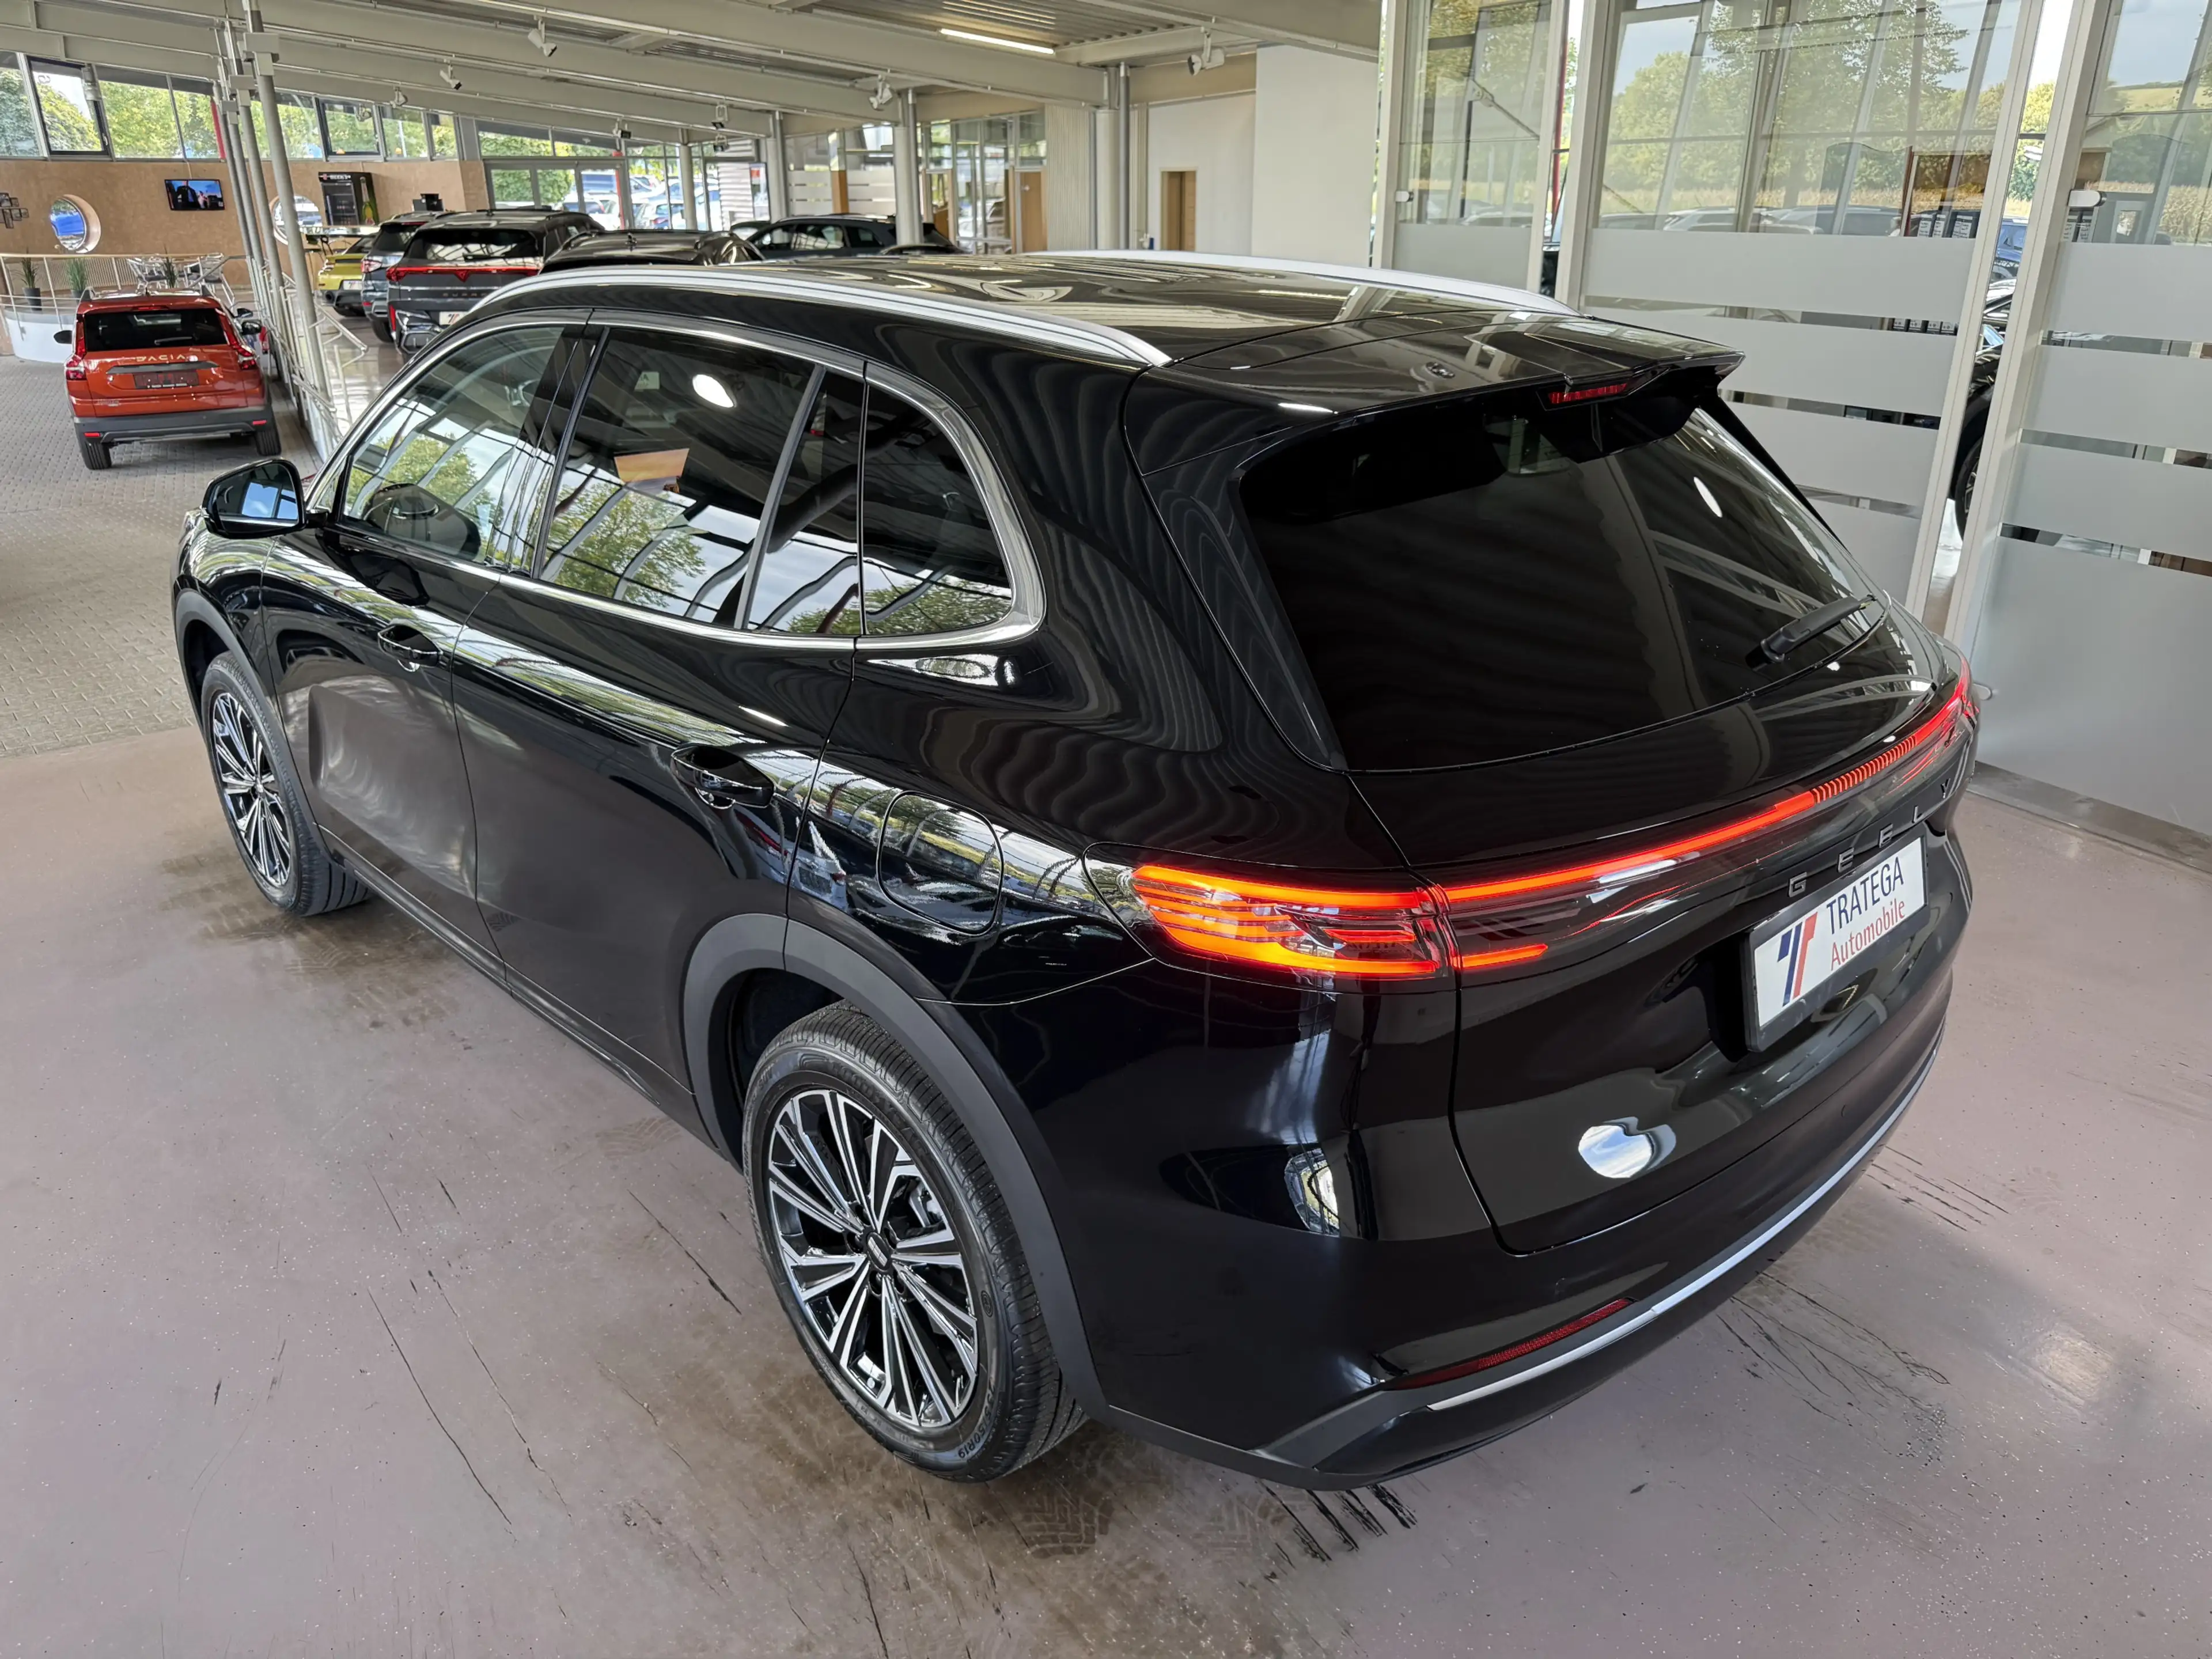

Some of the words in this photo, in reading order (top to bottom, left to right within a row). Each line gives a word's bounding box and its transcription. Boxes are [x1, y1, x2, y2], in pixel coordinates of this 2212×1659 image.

[135, 354, 185, 362] DACIA
[1788, 778, 1950, 897] GEELY
[1827, 857, 1904, 934] TRATEGA
[1831, 898, 1906, 971] Automobile
